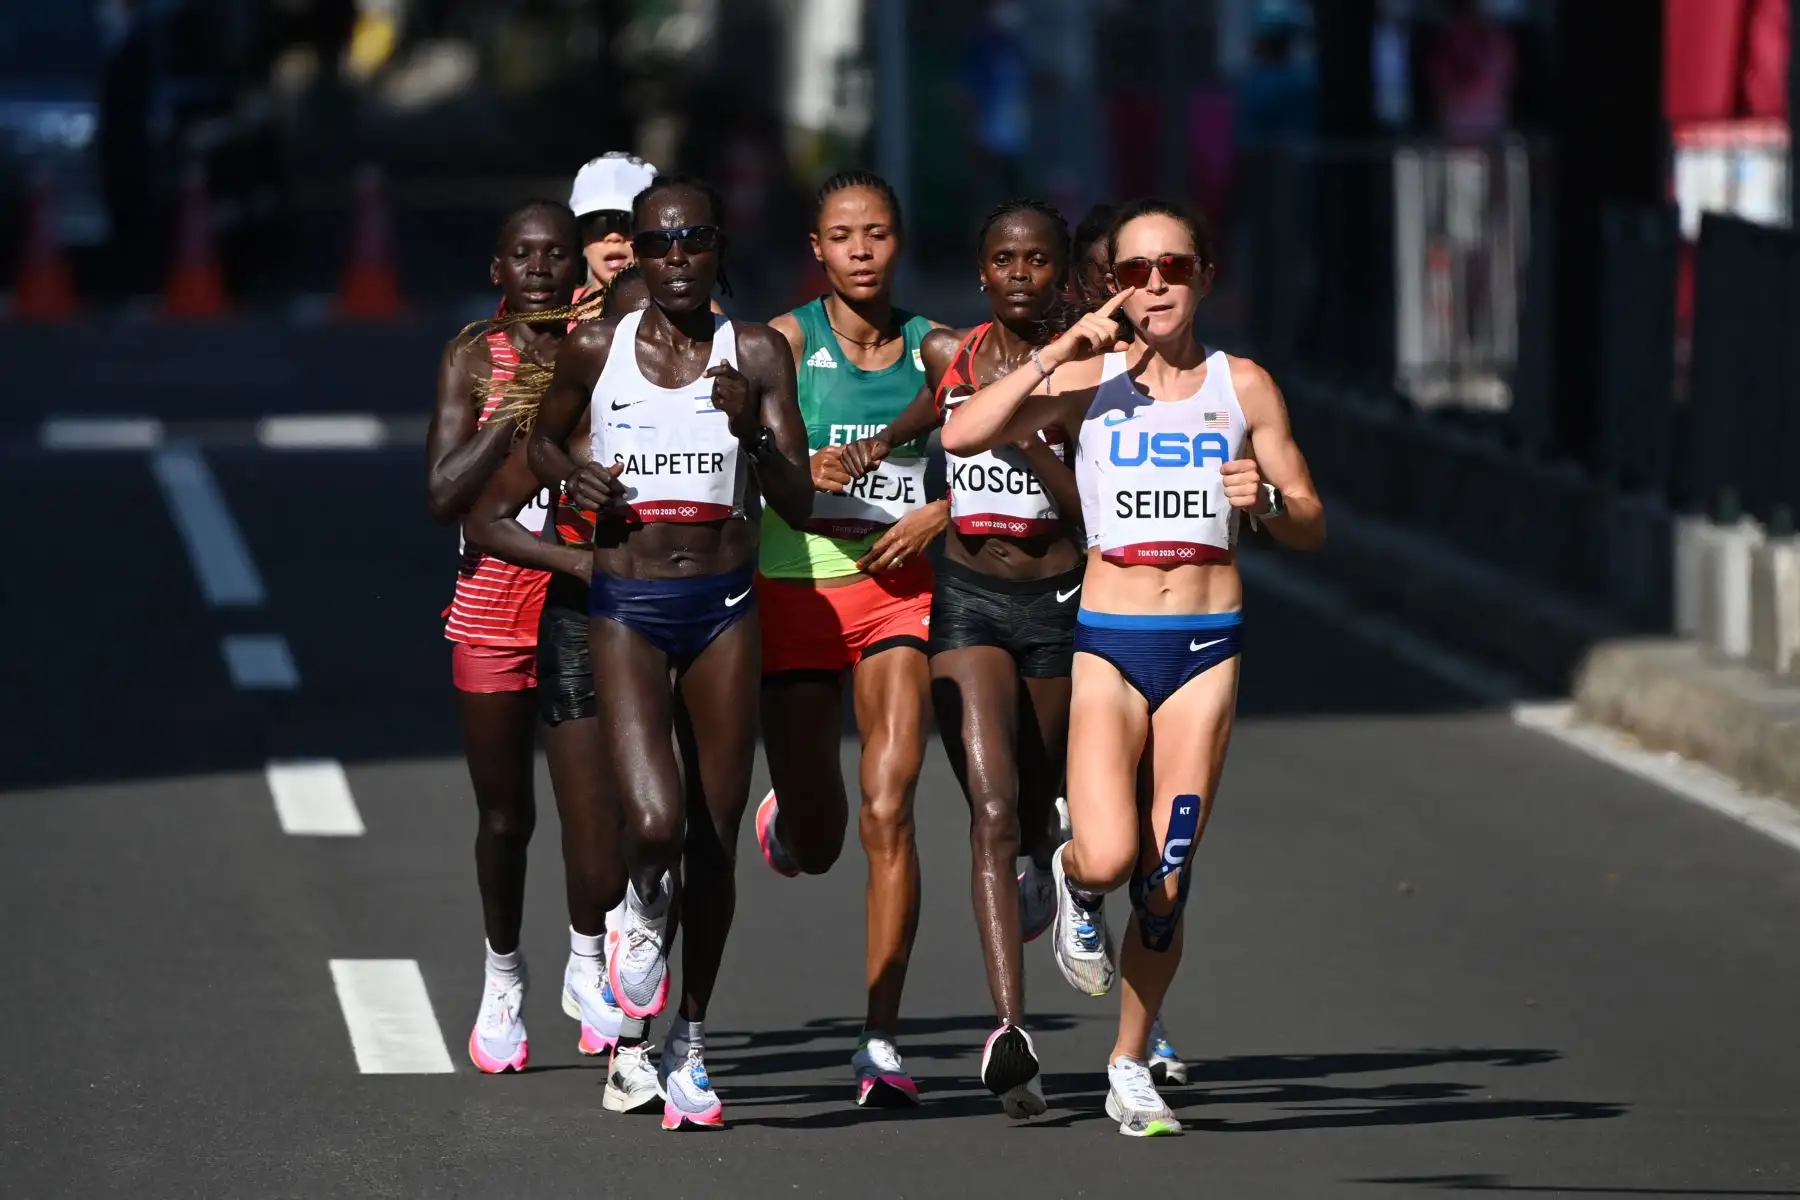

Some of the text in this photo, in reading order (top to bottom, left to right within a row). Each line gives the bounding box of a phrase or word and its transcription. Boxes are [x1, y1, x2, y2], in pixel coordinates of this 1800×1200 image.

[807, 358, 838, 369] adidas
[1109, 431, 1229, 467] USA
[614, 452, 724, 475] SALPETER
[952, 462, 1047, 495] KOSGE
[832, 472, 916, 503] REJE
[639, 508, 660, 516] TOKYO
[1116, 490, 1217, 519] SEIDEL
[971, 520, 1007, 529] TOKYO 2020
[1138, 549, 1175, 557] TOKYO 2020
[1179, 806, 1191, 815] KT
